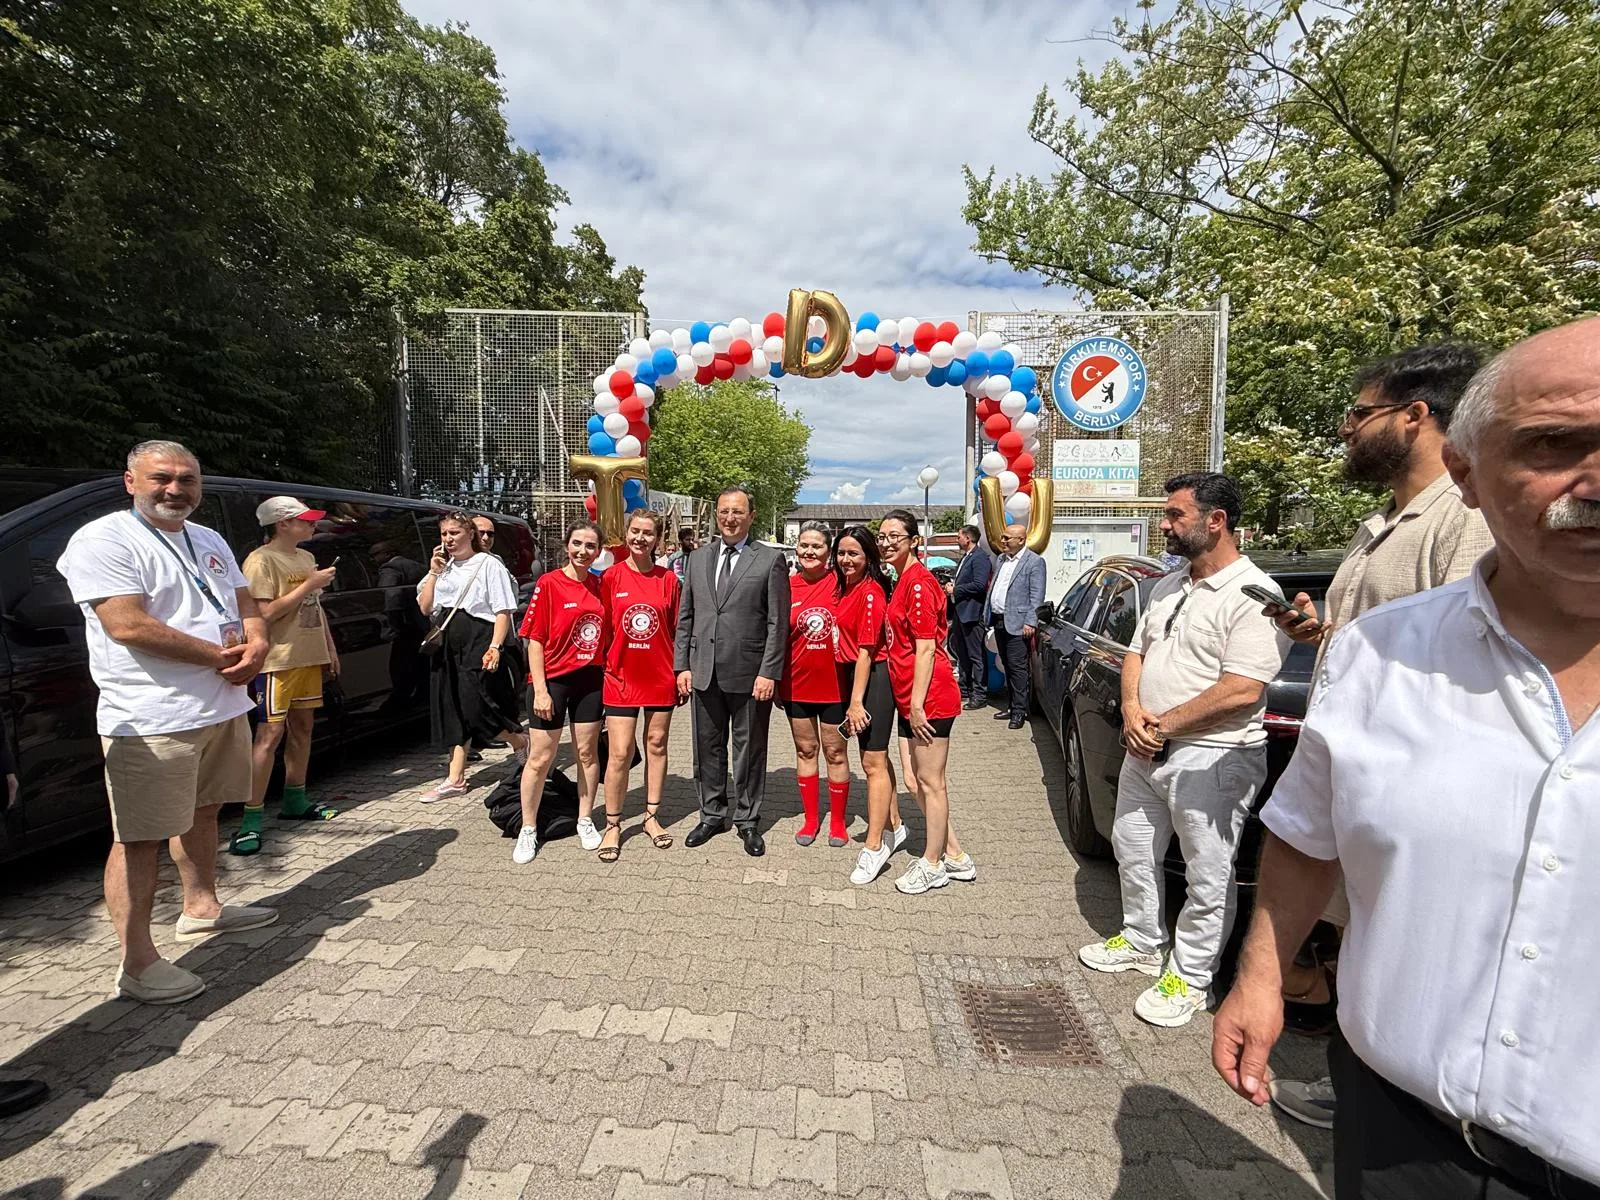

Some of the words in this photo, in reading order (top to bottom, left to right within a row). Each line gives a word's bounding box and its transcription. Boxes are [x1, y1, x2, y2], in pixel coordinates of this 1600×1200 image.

[783, 288, 851, 378] D
[1073, 410, 1121, 427] BERLIN
[569, 455, 647, 548] T
[1055, 467, 1105, 479] EUROPA
[1108, 467, 1136, 479] KITA
[981, 476, 1054, 556] U
